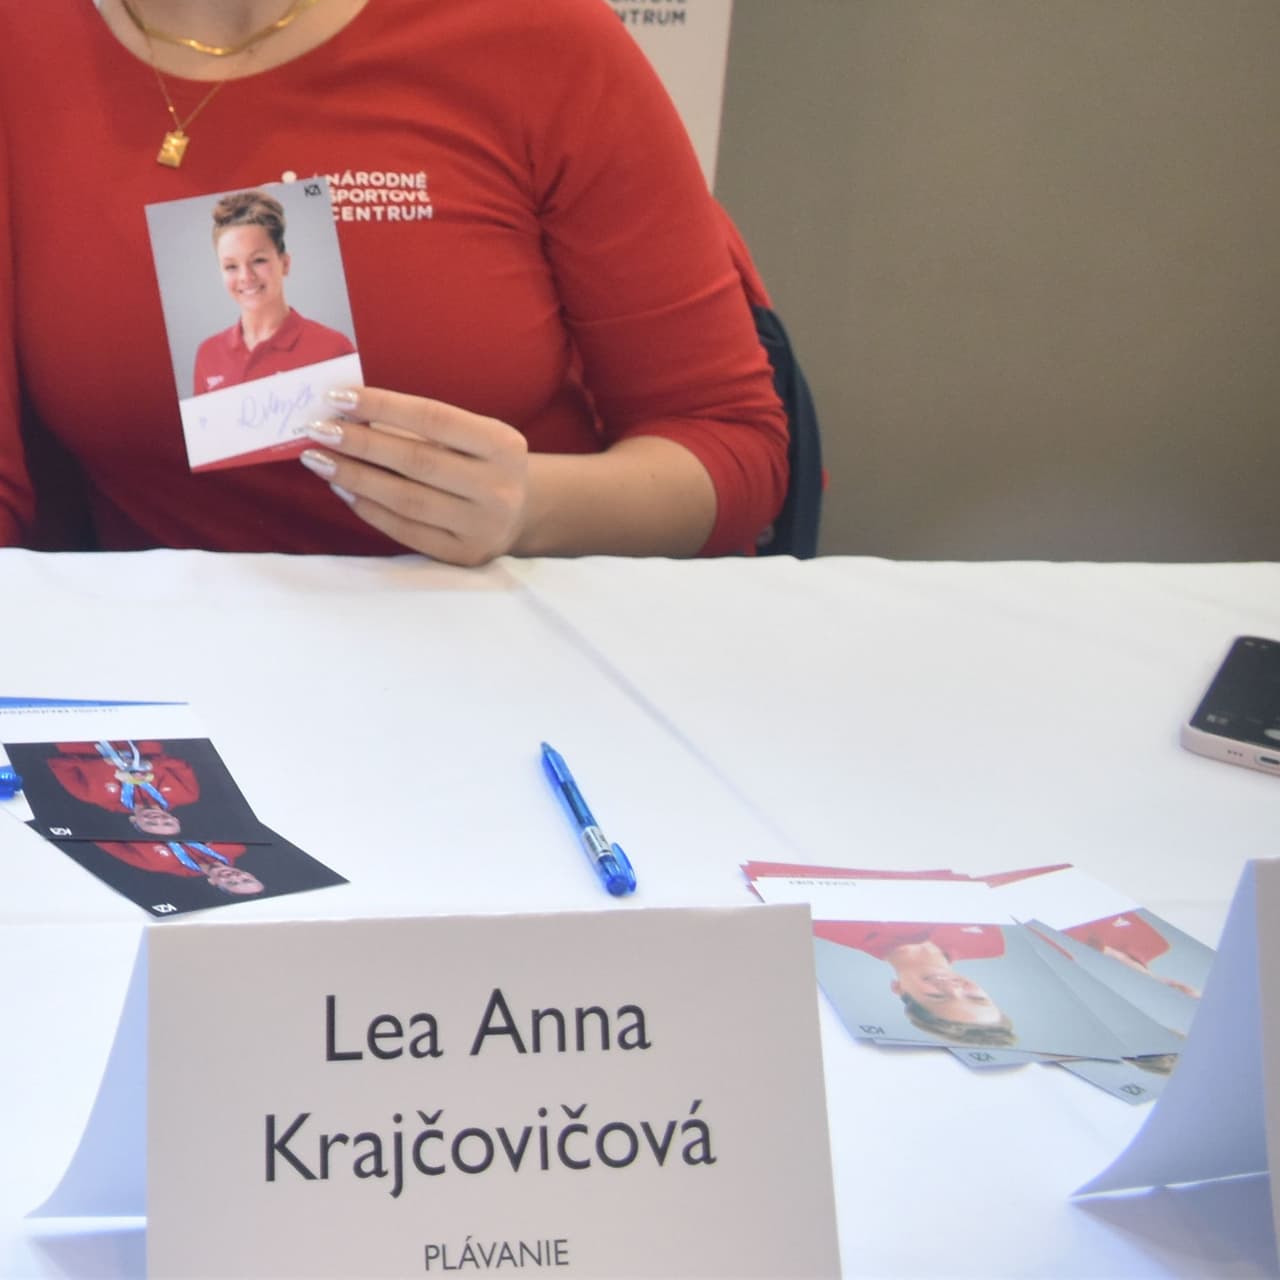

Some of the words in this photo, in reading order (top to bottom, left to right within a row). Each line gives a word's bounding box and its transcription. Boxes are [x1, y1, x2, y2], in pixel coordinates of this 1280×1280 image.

[326, 170, 427, 189] NÁRODNÉ
[325, 994, 444, 1062] Lea
[469, 988, 652, 1056] Anna
[265, 1099, 718, 1199] Krajčovičová
[424, 1235, 569, 1271] PLÁVANIE
